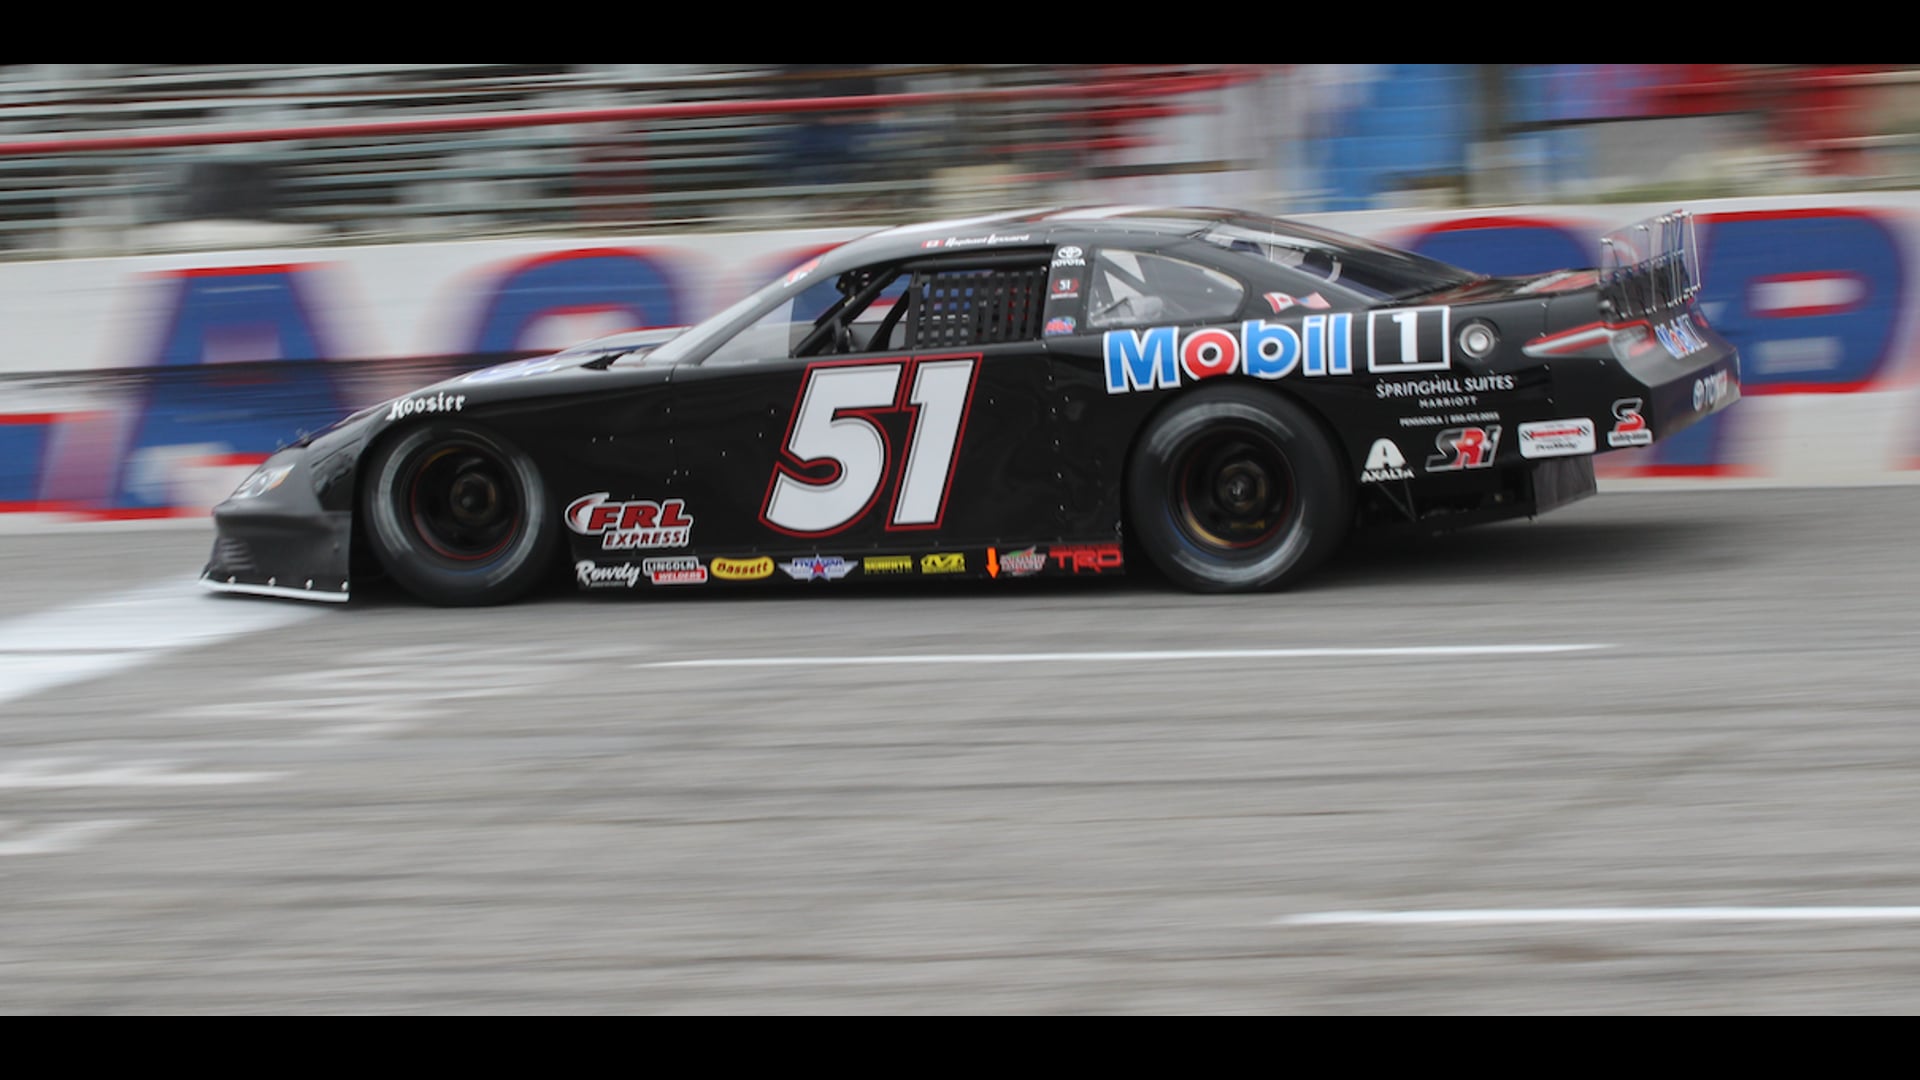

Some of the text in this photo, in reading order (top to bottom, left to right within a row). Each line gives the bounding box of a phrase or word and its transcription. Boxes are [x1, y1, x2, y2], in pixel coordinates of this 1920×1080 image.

[1051, 258, 1086, 268] TOYOTA
[1103, 311, 1418, 394] Mobil 1
[1376, 370, 1514, 399] SPRINGHILL SUITES
[385, 391, 466, 421] Hoosier
[1418, 395, 1478, 408] MARRIOTT
[766, 359, 973, 533] 51
[1361, 469, 1415, 482] AXALTA
[587, 502, 692, 531] FRL
[576, 560, 640, 587] Rowdy
[647, 560, 695, 571] LINCOLN
[1049, 549, 1122, 573] TRD
